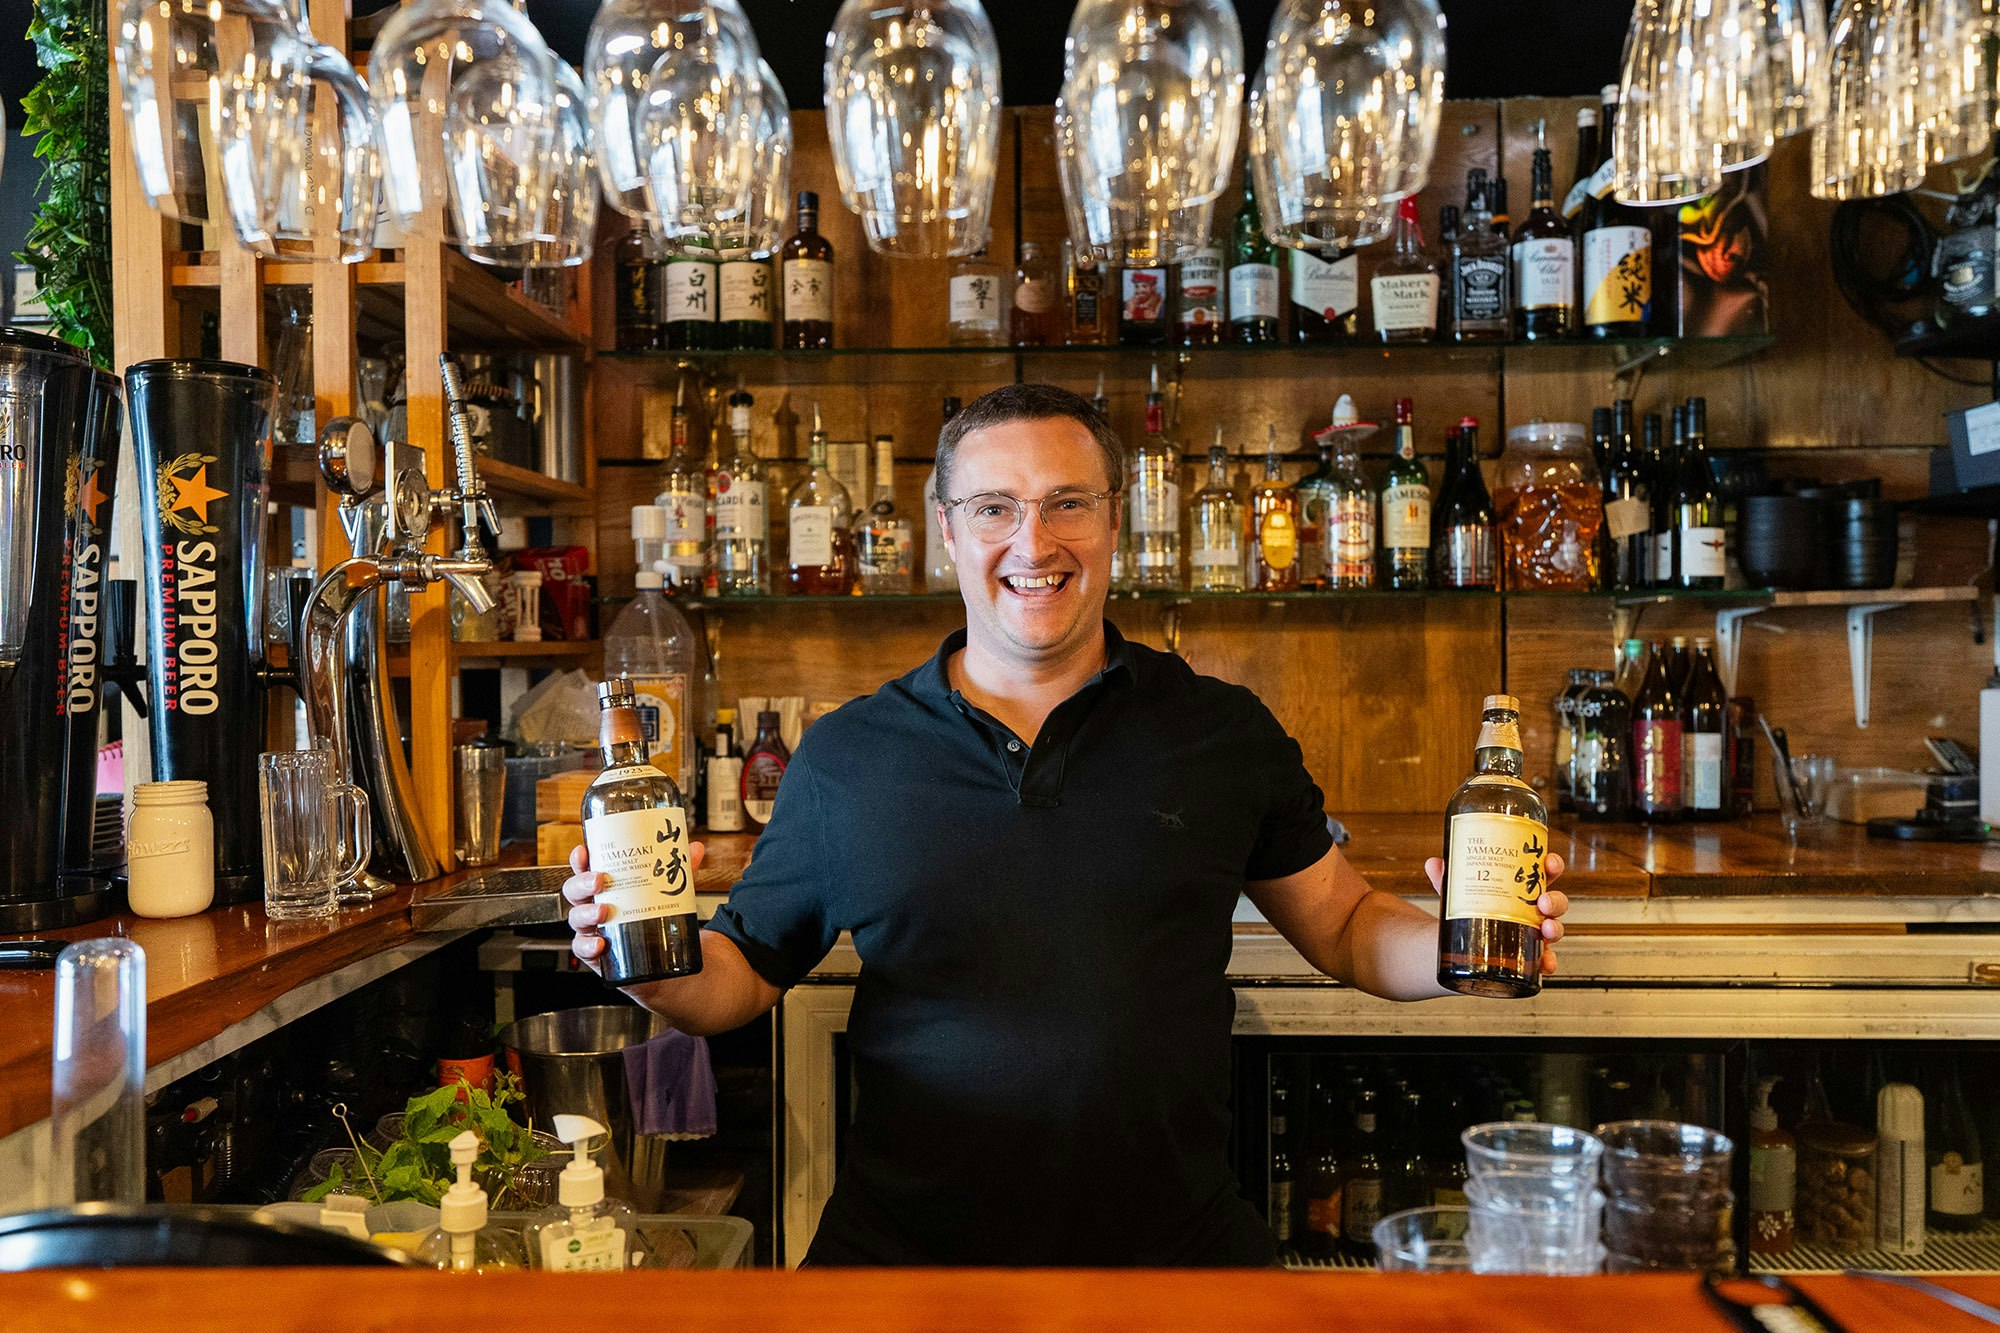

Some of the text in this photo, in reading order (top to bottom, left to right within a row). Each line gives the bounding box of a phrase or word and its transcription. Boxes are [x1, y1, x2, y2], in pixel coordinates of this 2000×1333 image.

[685, 268, 708, 313] 白州
[749, 268, 769, 312] 白州
[1393, 289, 1430, 299] Mark
[1617, 253, 1646, 314] 純米
[56, 539, 72, 716] PREMIUM BEER
[67, 541, 100, 716] SAPPORO
[161, 544, 177, 712] PREMIUM BEER
[176, 541, 219, 715] SAPPORO
[619, 767, 643, 775] 1923
[601, 841, 616, 850] THE
[601, 845, 654, 862] YAMAZAKI
[653, 818, 687, 897] 山崎
[1467, 846, 1519, 858] YAMAZAKI
[1477, 869, 1490, 881] 12
[1514, 834, 1545, 906] 山崎
[622, 903, 680, 916] DISTILLER'S RESERVE
